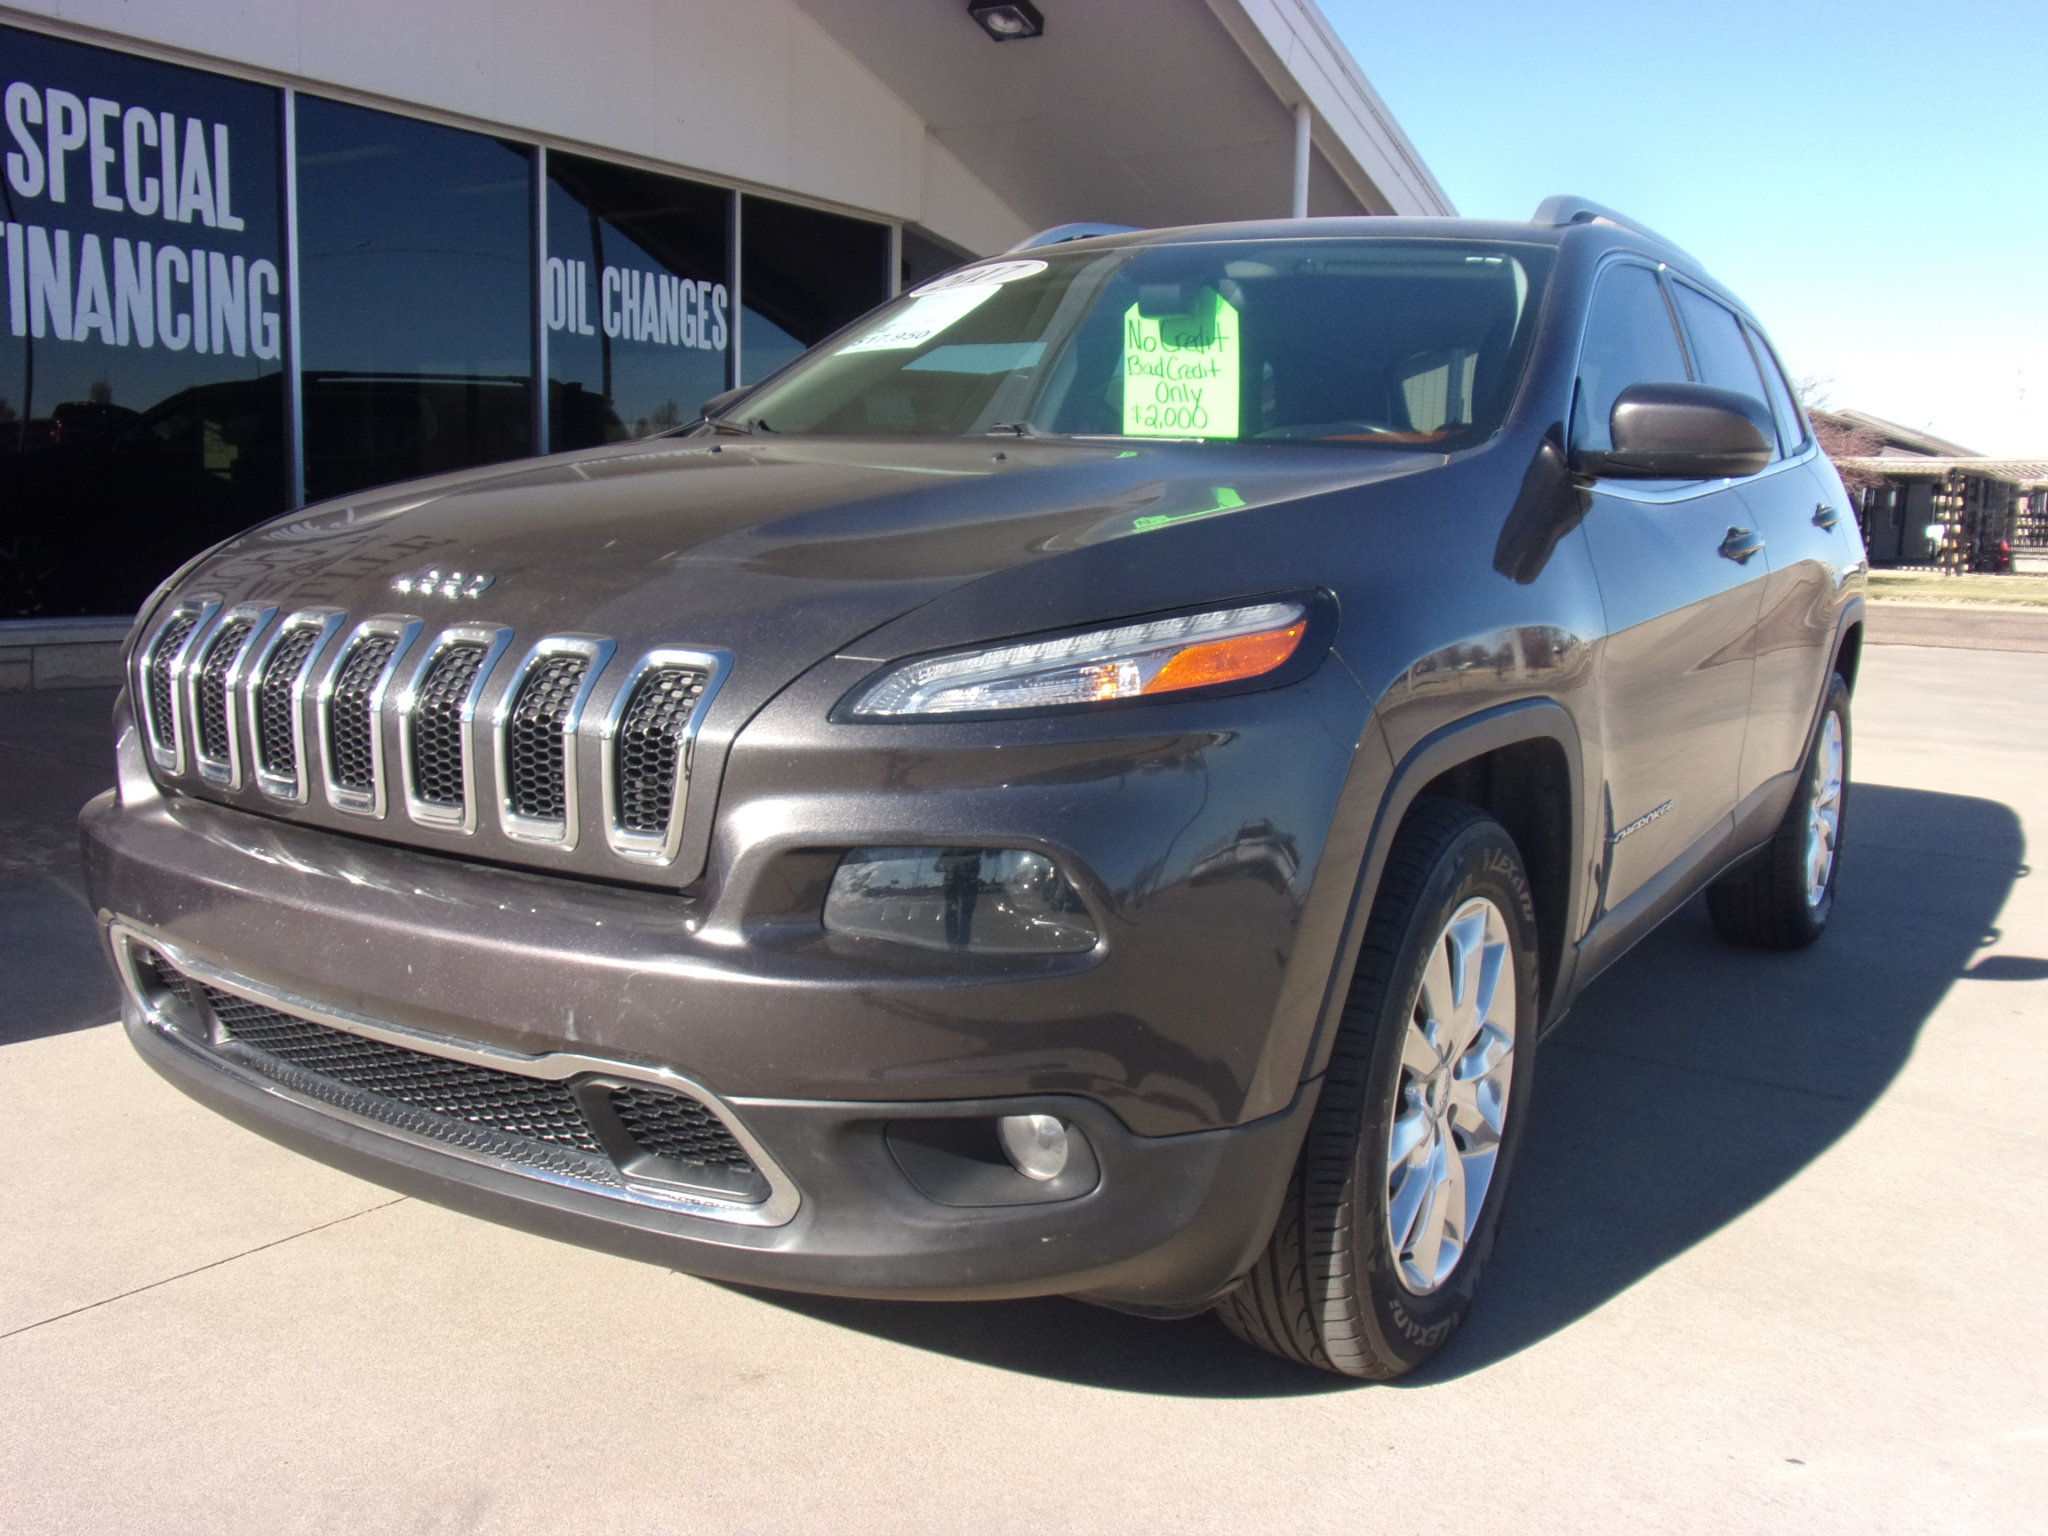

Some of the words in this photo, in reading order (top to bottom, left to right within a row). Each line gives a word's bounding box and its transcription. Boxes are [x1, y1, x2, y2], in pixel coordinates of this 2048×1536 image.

[4, 81, 245, 232] SPECIAL
[0, 220, 281, 360] INANCING
[546, 256, 595, 336] OIL
[602, 265, 728, 351] CHANGES
[1128, 318, 1157, 352] No
[1160, 318, 1230, 355] Credit
[1127, 354, 1164, 379] Bad
[1166, 355, 1222, 381] Credit
[1155, 381, 1203, 409] Only
[1130, 403, 1208, 430] $2,000
